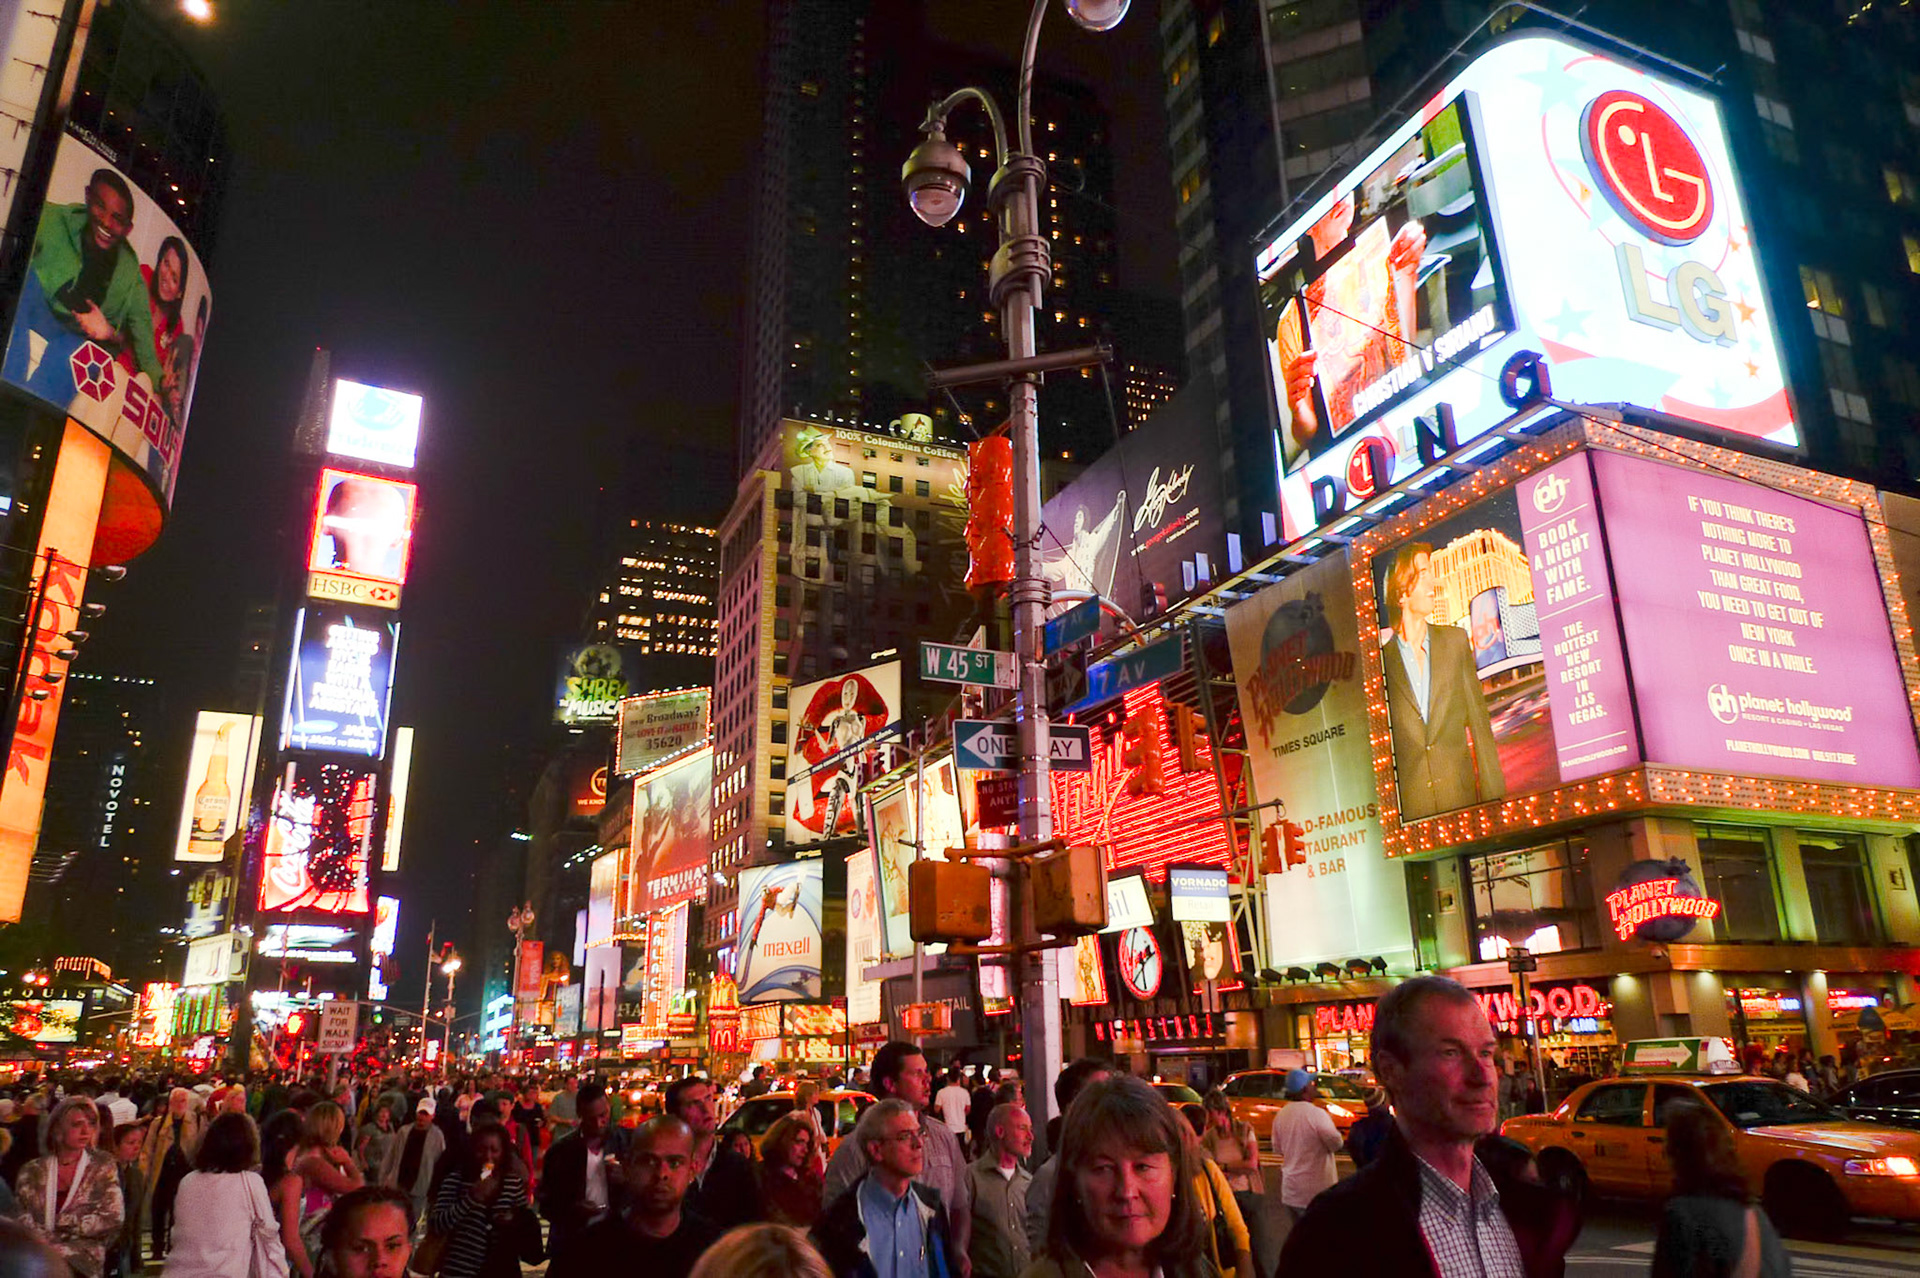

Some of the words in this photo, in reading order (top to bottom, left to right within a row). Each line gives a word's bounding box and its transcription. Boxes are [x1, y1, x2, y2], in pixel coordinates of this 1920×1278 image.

[1615, 241, 1738, 348] LG
[1352, 354, 1423, 419] CHRISTIAN
[835, 429, 861, 442] 100%
[864, 434, 921, 453] Colombian
[1688, 495, 1700, 512] IF
[1699, 498, 1723, 517] YOU
[1722, 503, 1755, 525] THINK
[1753, 510, 1796, 534] THERE'S
[1538, 518, 1578, 549] BOOK
[1701, 521, 1747, 546] NOTHING
[1747, 530, 1778, 552] MORE
[1777, 538, 1793, 555] TO
[1534, 554, 1544, 571] A
[1545, 532, 1589, 566] NIGHT
[1701, 544, 1740, 567] PLANET
[1741, 552, 1802, 579] HOLLYWOOD
[1544, 556, 1583, 586] WITH
[313, 577, 367, 598] HSBC
[1546, 575, 1592, 605] FAME.
[1709, 569, 1739, 590] THAN
[1739, 575, 1773, 596] GREAT
[1773, 582, 1805, 604] FOOD,
[1697, 590, 1722, 611] YOU
[1721, 594, 1751, 616] NEED
[1750, 600, 1767, 619] TO
[1766, 603, 1788, 622] GET
[1788, 607, 1810, 626] OUT
[1809, 611, 1824, 629] OF
[1057, 617, 1067, 639] 7
[1069, 610, 1085, 624] AV
[1562, 620, 1584, 639] THE
[1740, 622, 1767, 642] NEW
[1766, 626, 1796, 647] YORK
[1553, 629, 1599, 657] HOTTEST
[1566, 648, 1591, 667] NEW
[925, 646, 940, 676] W
[946, 650, 969, 679] 45
[975, 653, 990, 669] ST
[1560, 659, 1602, 685] RESORT
[1728, 644, 1759, 666] ONCE
[1758, 649, 1772, 668] IN
[1772, 652, 1782, 669] A
[1780, 653, 1818, 674] WHILE.
[1099, 669, 1110, 695] 7
[1118, 660, 1147, 688] AV
[1576, 678, 1590, 694] IN
[646, 706, 701, 723] Broadway?
[1574, 691, 1596, 709] LAS
[1738, 691, 1785, 714] planet
[1785, 697, 1852, 722] hollywood
[1568, 704, 1608, 726] VEGAS.
[1742, 712, 1770, 724] RESORT
[1777, 718, 1803, 728] CASINO
[1809, 722, 1822, 730] LAS
[1822, 724, 1845, 733] VEGAS
[645, 734, 683, 751] 35620
[977, 735, 1017, 756] ONE
[1050, 739, 1074, 758] AY
[1272, 738, 1301, 758] TIMES
[1303, 723, 1346, 748] SQUARE
[100, 764, 126, 848] NOVOTEL
[197, 795, 228, 806] Corona
[1303, 802, 1377, 834] D-FAMOUS
[647, 864, 708, 893] TERMINAT
[1171, 877, 1228, 888] VORNADO
[1307, 863, 1316, 879] &
[1319, 857, 1346, 877] BAR
[653, 877, 708, 900] SALVATIO
[1605, 878, 1679, 922] PLANET
[1614, 896, 1721, 942] HOLLYWOOD
[649, 920, 663, 1003] PALACE
[763, 936, 811, 959] maxell
[329, 1006, 352, 1015] WAIT
[329, 1017, 348, 1027] FOR
[1316, 1002, 1377, 1033] PLAN
[324, 1029, 349, 1039] WALK
